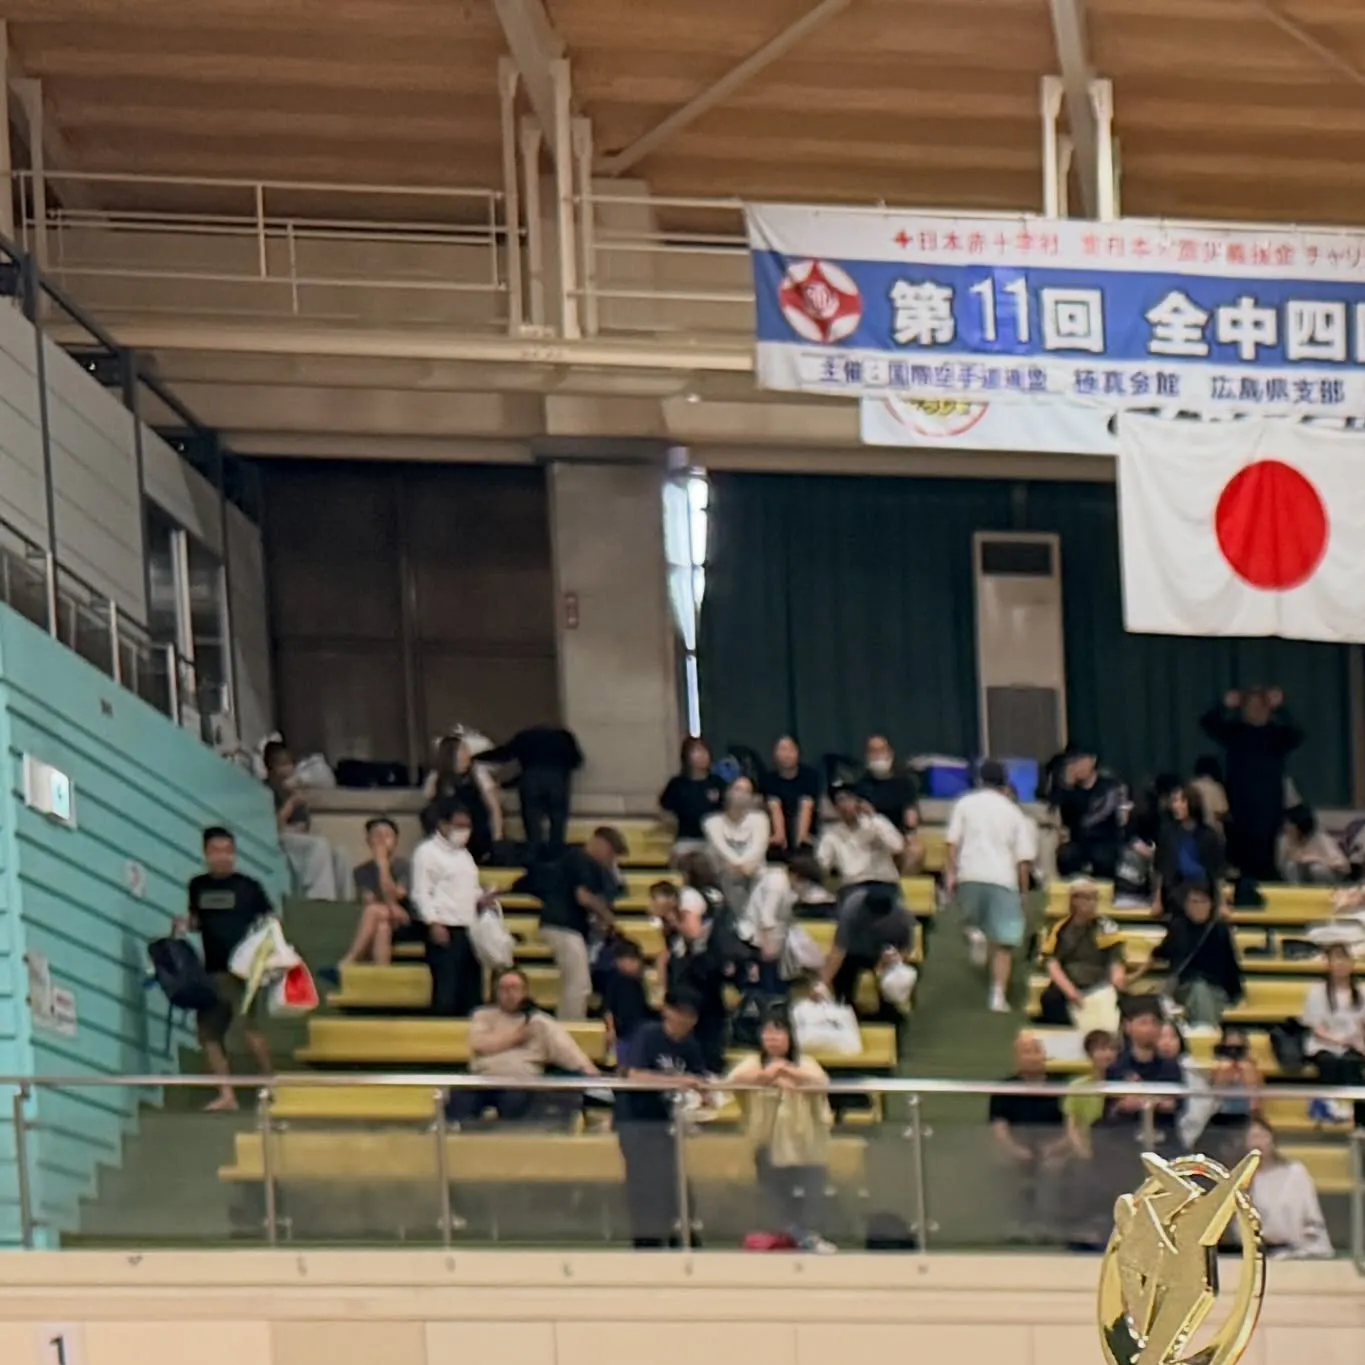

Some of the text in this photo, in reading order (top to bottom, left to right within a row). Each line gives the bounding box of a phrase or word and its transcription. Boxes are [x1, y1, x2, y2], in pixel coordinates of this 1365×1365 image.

[889, 271, 1106, 354] 第11回
[1209, 374, 1345, 405] 広島県支部
